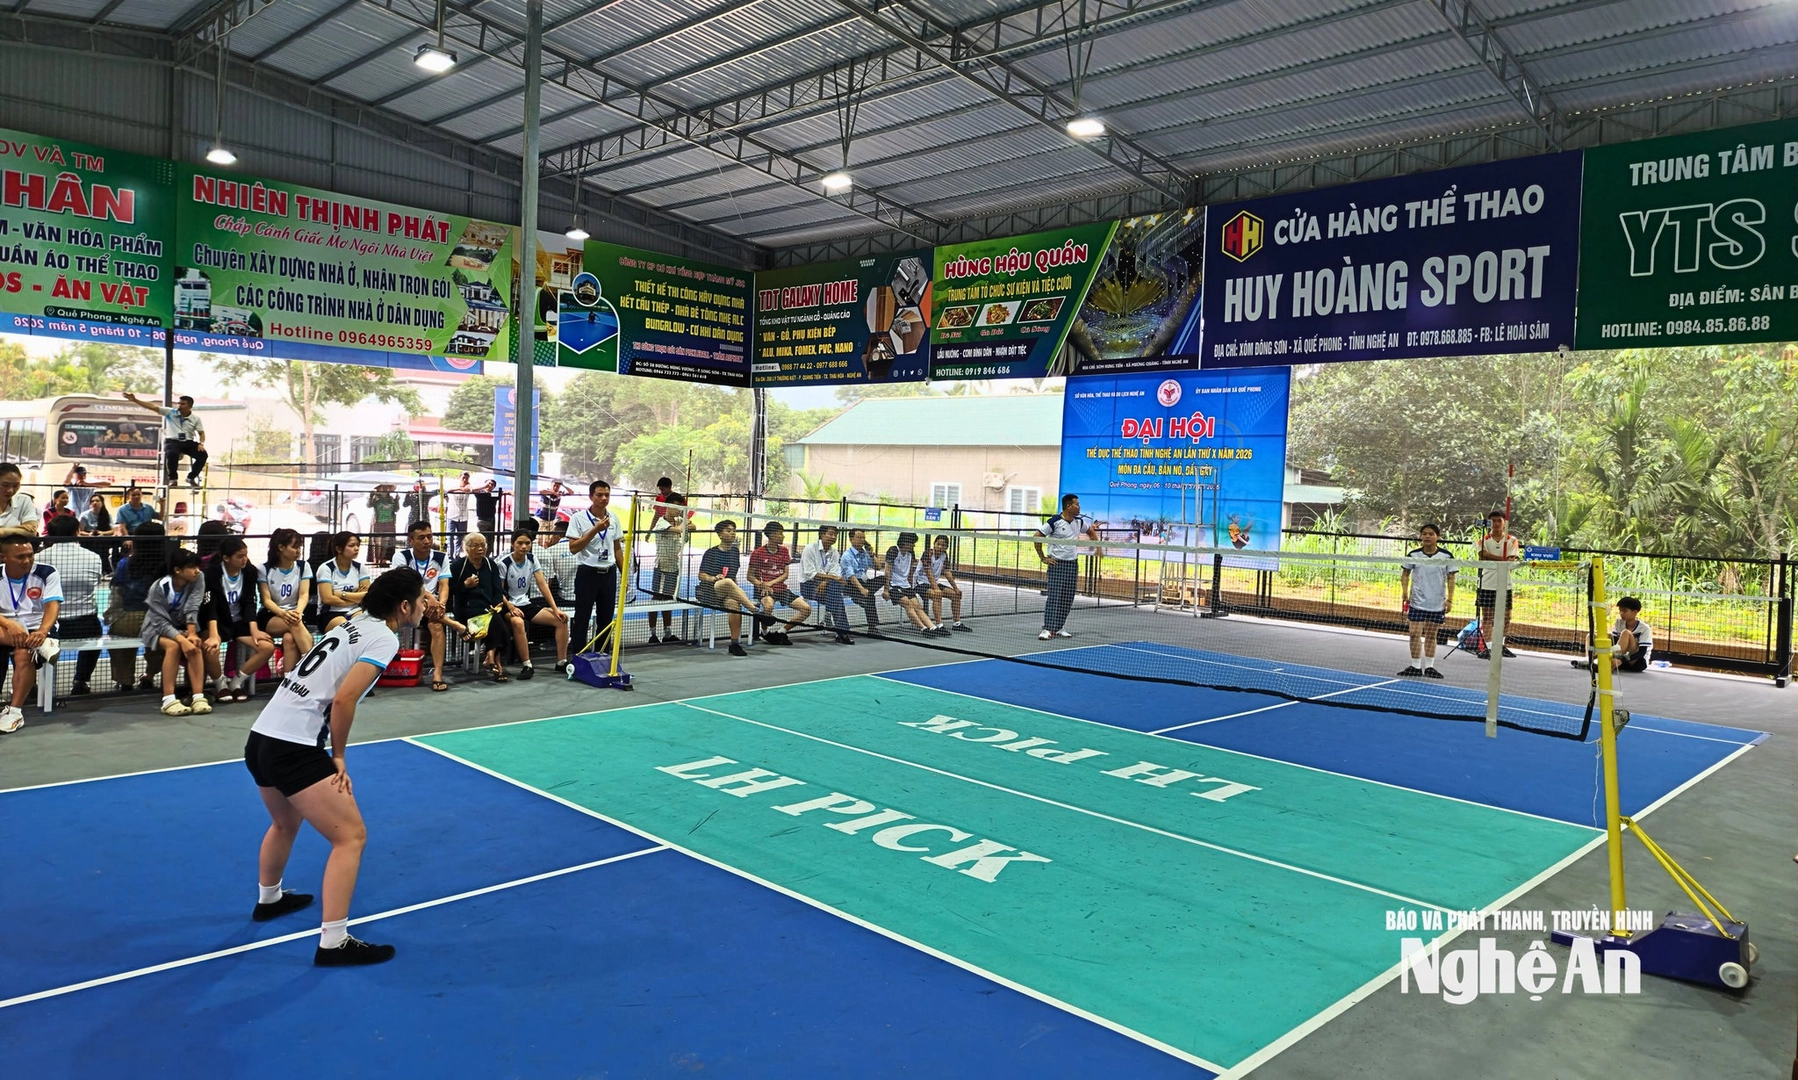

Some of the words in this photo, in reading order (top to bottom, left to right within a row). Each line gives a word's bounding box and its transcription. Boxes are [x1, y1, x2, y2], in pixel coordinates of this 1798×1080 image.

[33, 144, 66, 166] VÀ
[71, 152, 104, 172] TM
[1629, 153, 1710, 186] TRUNG
[1718, 144, 1774, 175] TÂM
[193, 174, 288, 217] NHIÊN
[294, 194, 379, 233] THỊNH
[387, 214, 451, 245] PHÁT
[1273, 207, 1321, 246] CỬA
[1328, 203, 1399, 239] HÀNG
[1405, 184, 1457, 229] THỂ
[1463, 184, 1545, 222] THAO
[22, 221, 61, 242] VĂN
[67, 228, 104, 248] HÓA
[110, 232, 162, 256] PHẨM
[214, 214, 251, 237] Chắp
[254, 222, 290, 241] Cánh
[293, 229, 324, 246] Giấc
[325, 234, 349, 249] Mơ
[350, 239, 379, 255] Ngôi
[382, 244, 408, 259] Nhà
[409, 246, 434, 263] Việt
[1619, 198, 1766, 277] YTS
[44, 250, 70, 269] ÁO
[75, 253, 110, 275] THỂ
[114, 260, 159, 281] THAO
[194, 244, 246, 271] Chuyên
[249, 250, 276, 275] XÂY
[280, 256, 315, 282] DỰNG
[319, 261, 345, 285] NHÀ
[348, 261, 360, 289] Ở,
[363, 268, 396, 294] NHẬN
[399, 274, 429, 298] TRỌN
[432, 276, 450, 299] GÓI
[944, 254, 991, 279] HÙNG
[995, 247, 1031, 276] HẬU
[1035, 239, 1088, 274] QUÁN
[51, 274, 92, 301] ĂN
[99, 281, 149, 311] VẶT
[759, 289, 779, 312] TDT
[782, 285, 822, 310] GALAXY
[824, 279, 858, 306] HOME
[948, 288, 966, 302] TRUNG
[1032, 277, 1040, 293] VÀ
[1224, 274, 1284, 323] HUY
[1292, 256, 1408, 318] HOÀNG
[1421, 244, 1551, 308] SPORT
[1669, 293, 1695, 309] ĐỊA
[1699, 284, 1744, 306] ĐIỂM:
[1750, 284, 1784, 301] SÂN
[80, 311, 112, 322] Phong
[121, 316, 145, 325] Nghệ
[236, 283, 264, 308] CÁC
[268, 287, 304, 313] CÔNG
[307, 292, 345, 318] TRÌNH
[348, 298, 373, 321] NHÀ
[376, 298, 384, 322] Ở
[387, 302, 411, 325] DÂN
[414, 308, 444, 331] DỤNG
[270, 322, 333, 341] Hotline
[339, 330, 432, 351] 0964965359
[645, 318, 685, 334] BUNGALOW
[1239, 339, 1254, 356] XÓM
[1274, 338, 1287, 354] SƠN
[1304, 334, 1318, 354] QUẾ
[1319, 337, 1342, 352] PHONG
[1349, 331, 1365, 350] TỈNH
[1366, 331, 1387, 351] NGHỆ
[1388, 333, 1399, 348] AN
[1407, 332, 1418, 347] ĐT:
[1420, 328, 1472, 346] 0978.668.885
[1480, 327, 1492, 342] FB:
[1495, 323, 1505, 341] LÊ
[1507, 321, 1527, 341] HOÀI
[1529, 320, 1549, 339] SÂM
[1601, 322, 1662, 338] HOTLINE:
[1666, 315, 1770, 335] 0984.85.86.88
[835, 342, 853, 353] NANO
[936, 368, 964, 376] HOTLINE:
[965, 367, 981, 375] 0919
[983, 367, 995, 375] 846
[997, 366, 1010, 374] 686
[1121, 418, 1163, 444] ĐẠI
[1169, 411, 1216, 444] HỘI
[1124, 449, 1137, 458] THAO
[1173, 449, 1182, 458] AN
[1212, 449, 1216, 459] X
[1235, 449, 1252, 459] 2026
[227, 590, 239, 603] 10
[280, 584, 292, 597] 09
[517, 576, 526, 589] 08
[298, 637, 340, 679] 6
[654, 755, 807, 798] LH
[770, 792, 1054, 883] PICK
